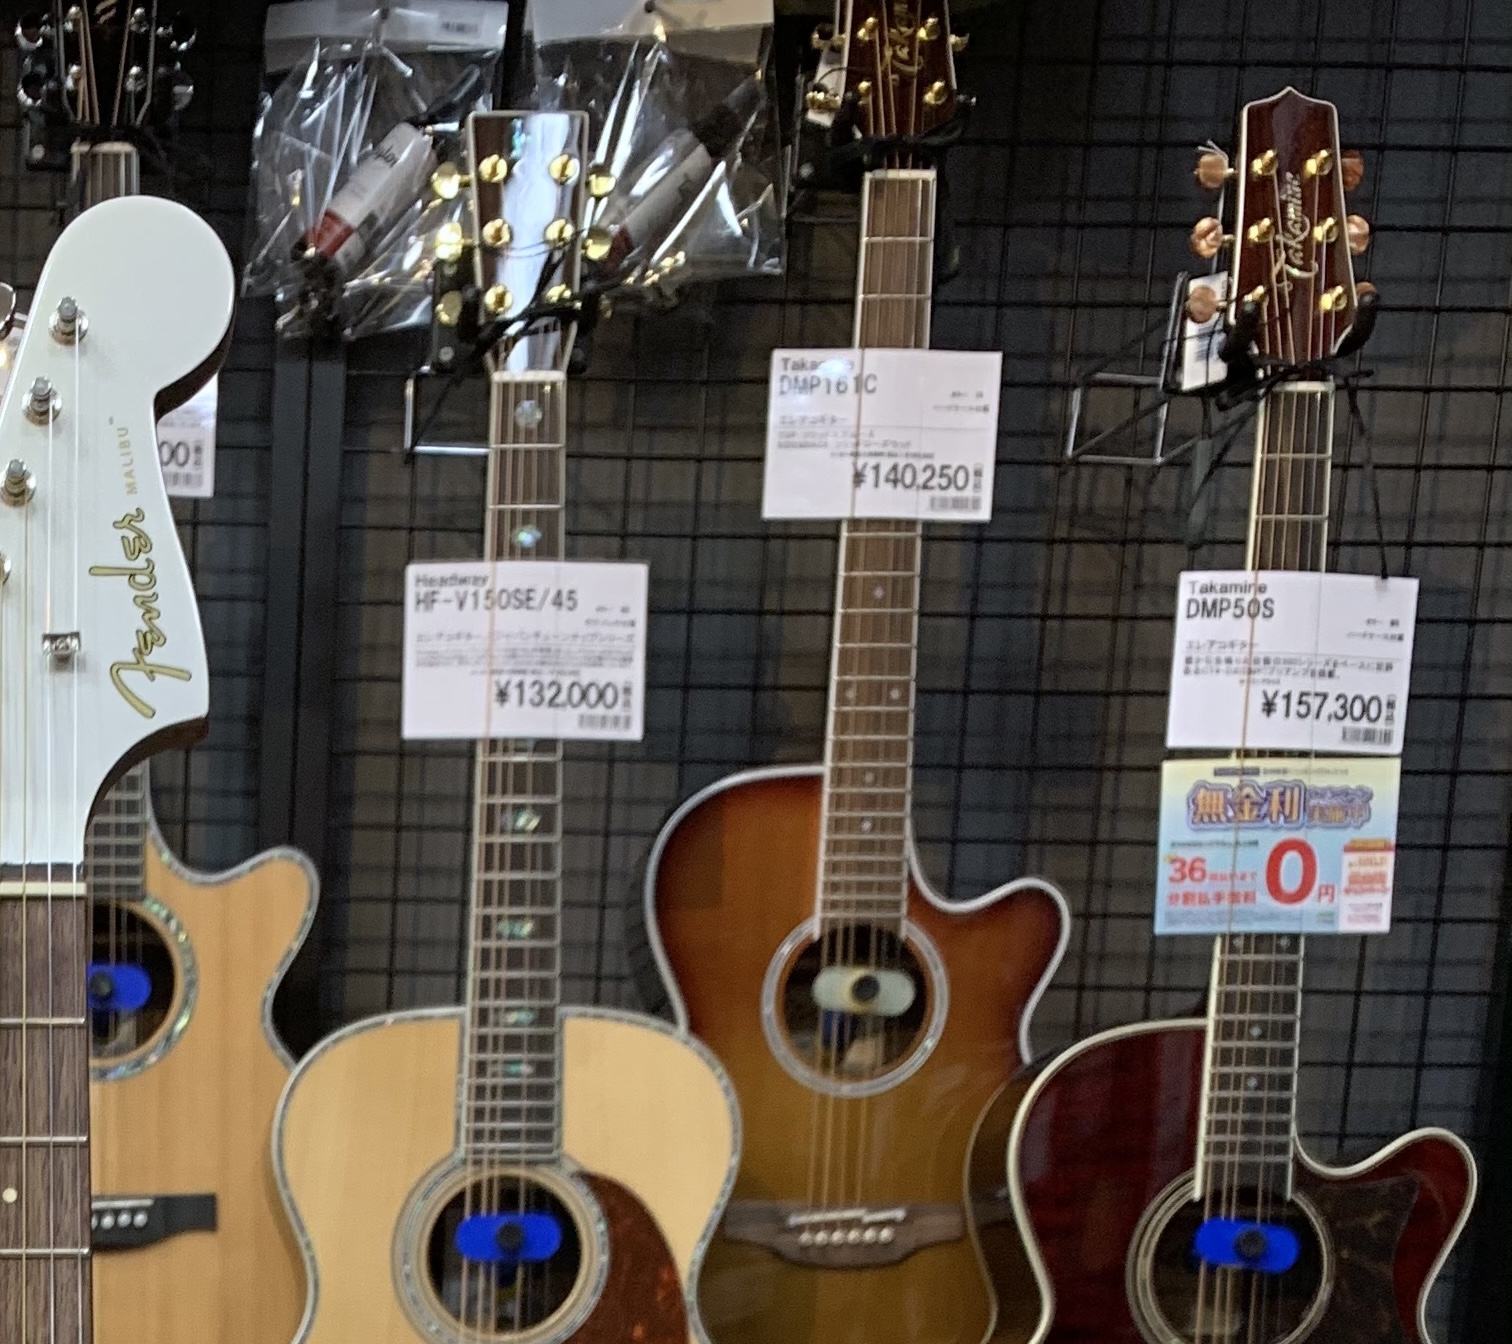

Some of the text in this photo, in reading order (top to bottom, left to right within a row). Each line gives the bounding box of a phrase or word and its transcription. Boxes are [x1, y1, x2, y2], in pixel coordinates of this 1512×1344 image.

[778, 374, 877, 396] DMP161C
[116, 427, 139, 496] MALIBU
[853, 461, 969, 491] ¥140,250
[415, 588, 578, 613] HF-V150SE/45
[1188, 580, 1267, 595] Takamine
[88, 507, 192, 718] Fender
[1186, 597, 1275, 619] DMP50S
[494, 679, 618, 709] ¥132,000
[1262, 690, 1382, 723] ¥157,300
[1192, 783, 1301, 826] 無金利
[1168, 856, 1206, 883] 36
[1265, 838, 1317, 904] 0
[1318, 884, 1336, 903] 円
